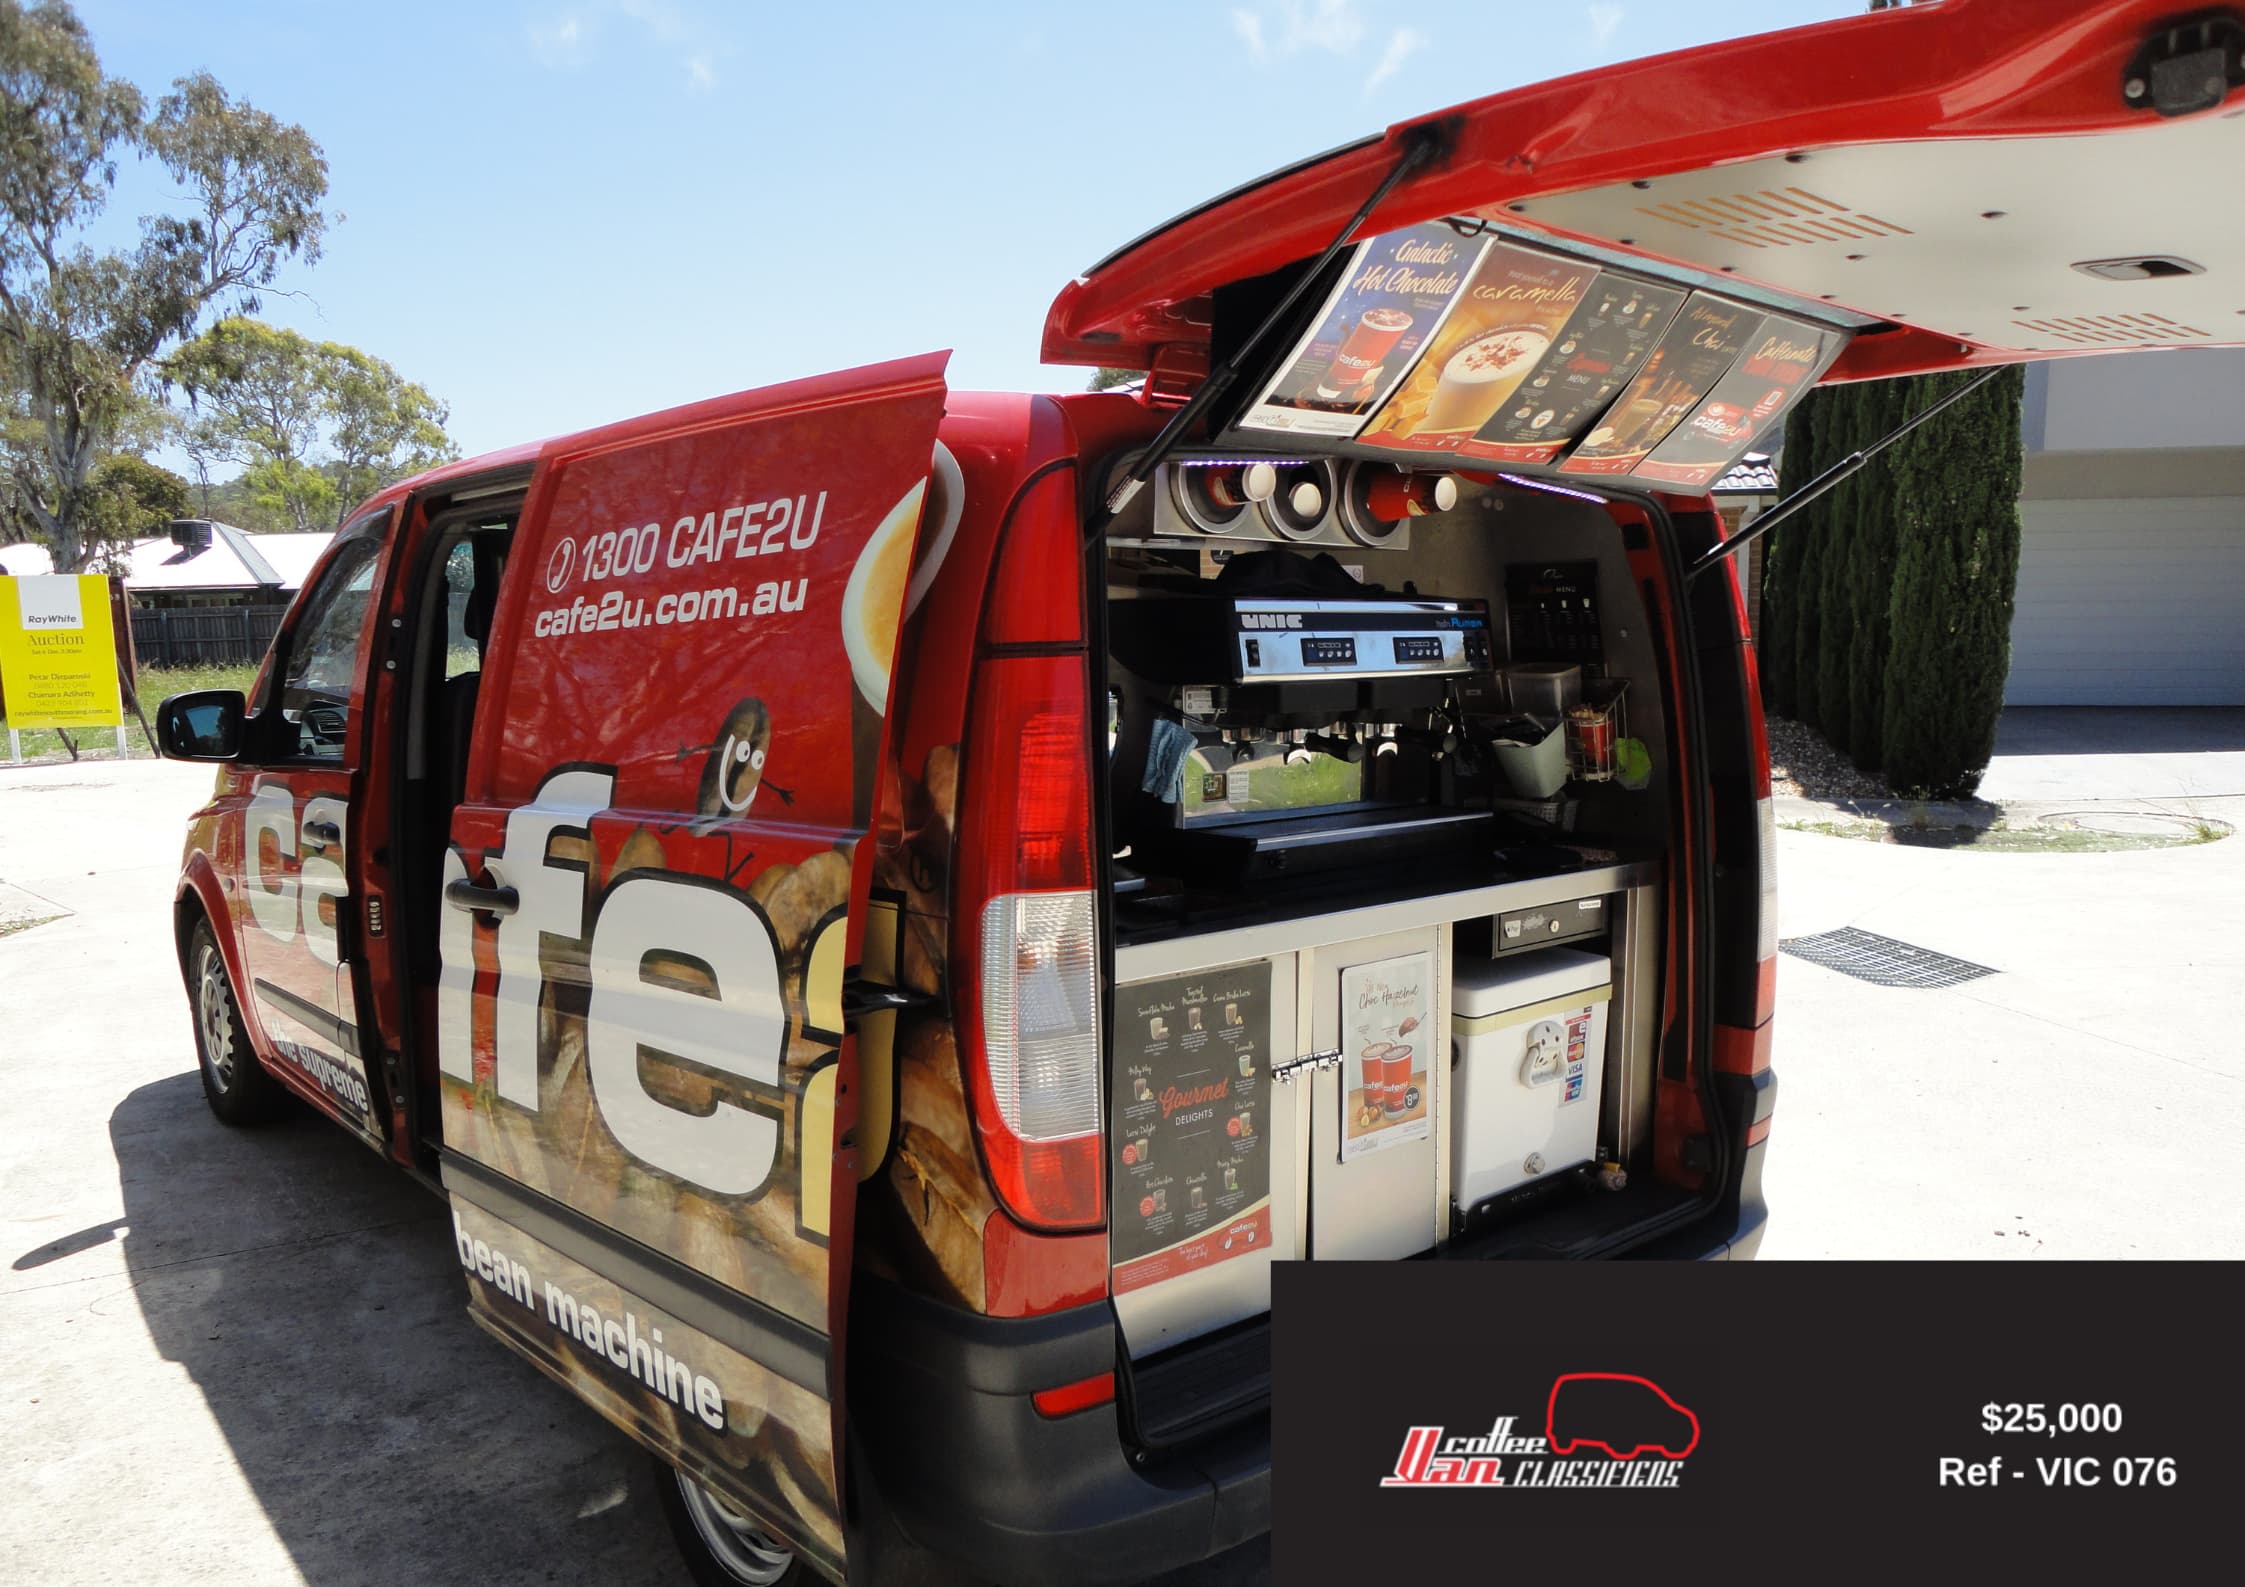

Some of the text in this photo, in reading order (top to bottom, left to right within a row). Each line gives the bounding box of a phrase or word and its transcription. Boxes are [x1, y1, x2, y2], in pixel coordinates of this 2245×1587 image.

[1353, 265, 1459, 296] Hot Chocolate
[1473, 276, 1581, 304] caramella
[1693, 328, 1731, 350] Chai
[582, 491, 828, 582] 1300 CAFE2U
[535, 578, 809, 637] cafe2u.com.au
[1241, 614, 1303, 629] UNIC
[29, 633, 84, 646] Auction
[299, 1045, 369, 1112] supreme
[1568, 1063, 1583, 1075] VISA
[1158, 1077, 1230, 1119] Gourmet
[1175, 1109, 1213, 1127] DELIGHTS
[453, 1210, 725, 1430] bean machine
